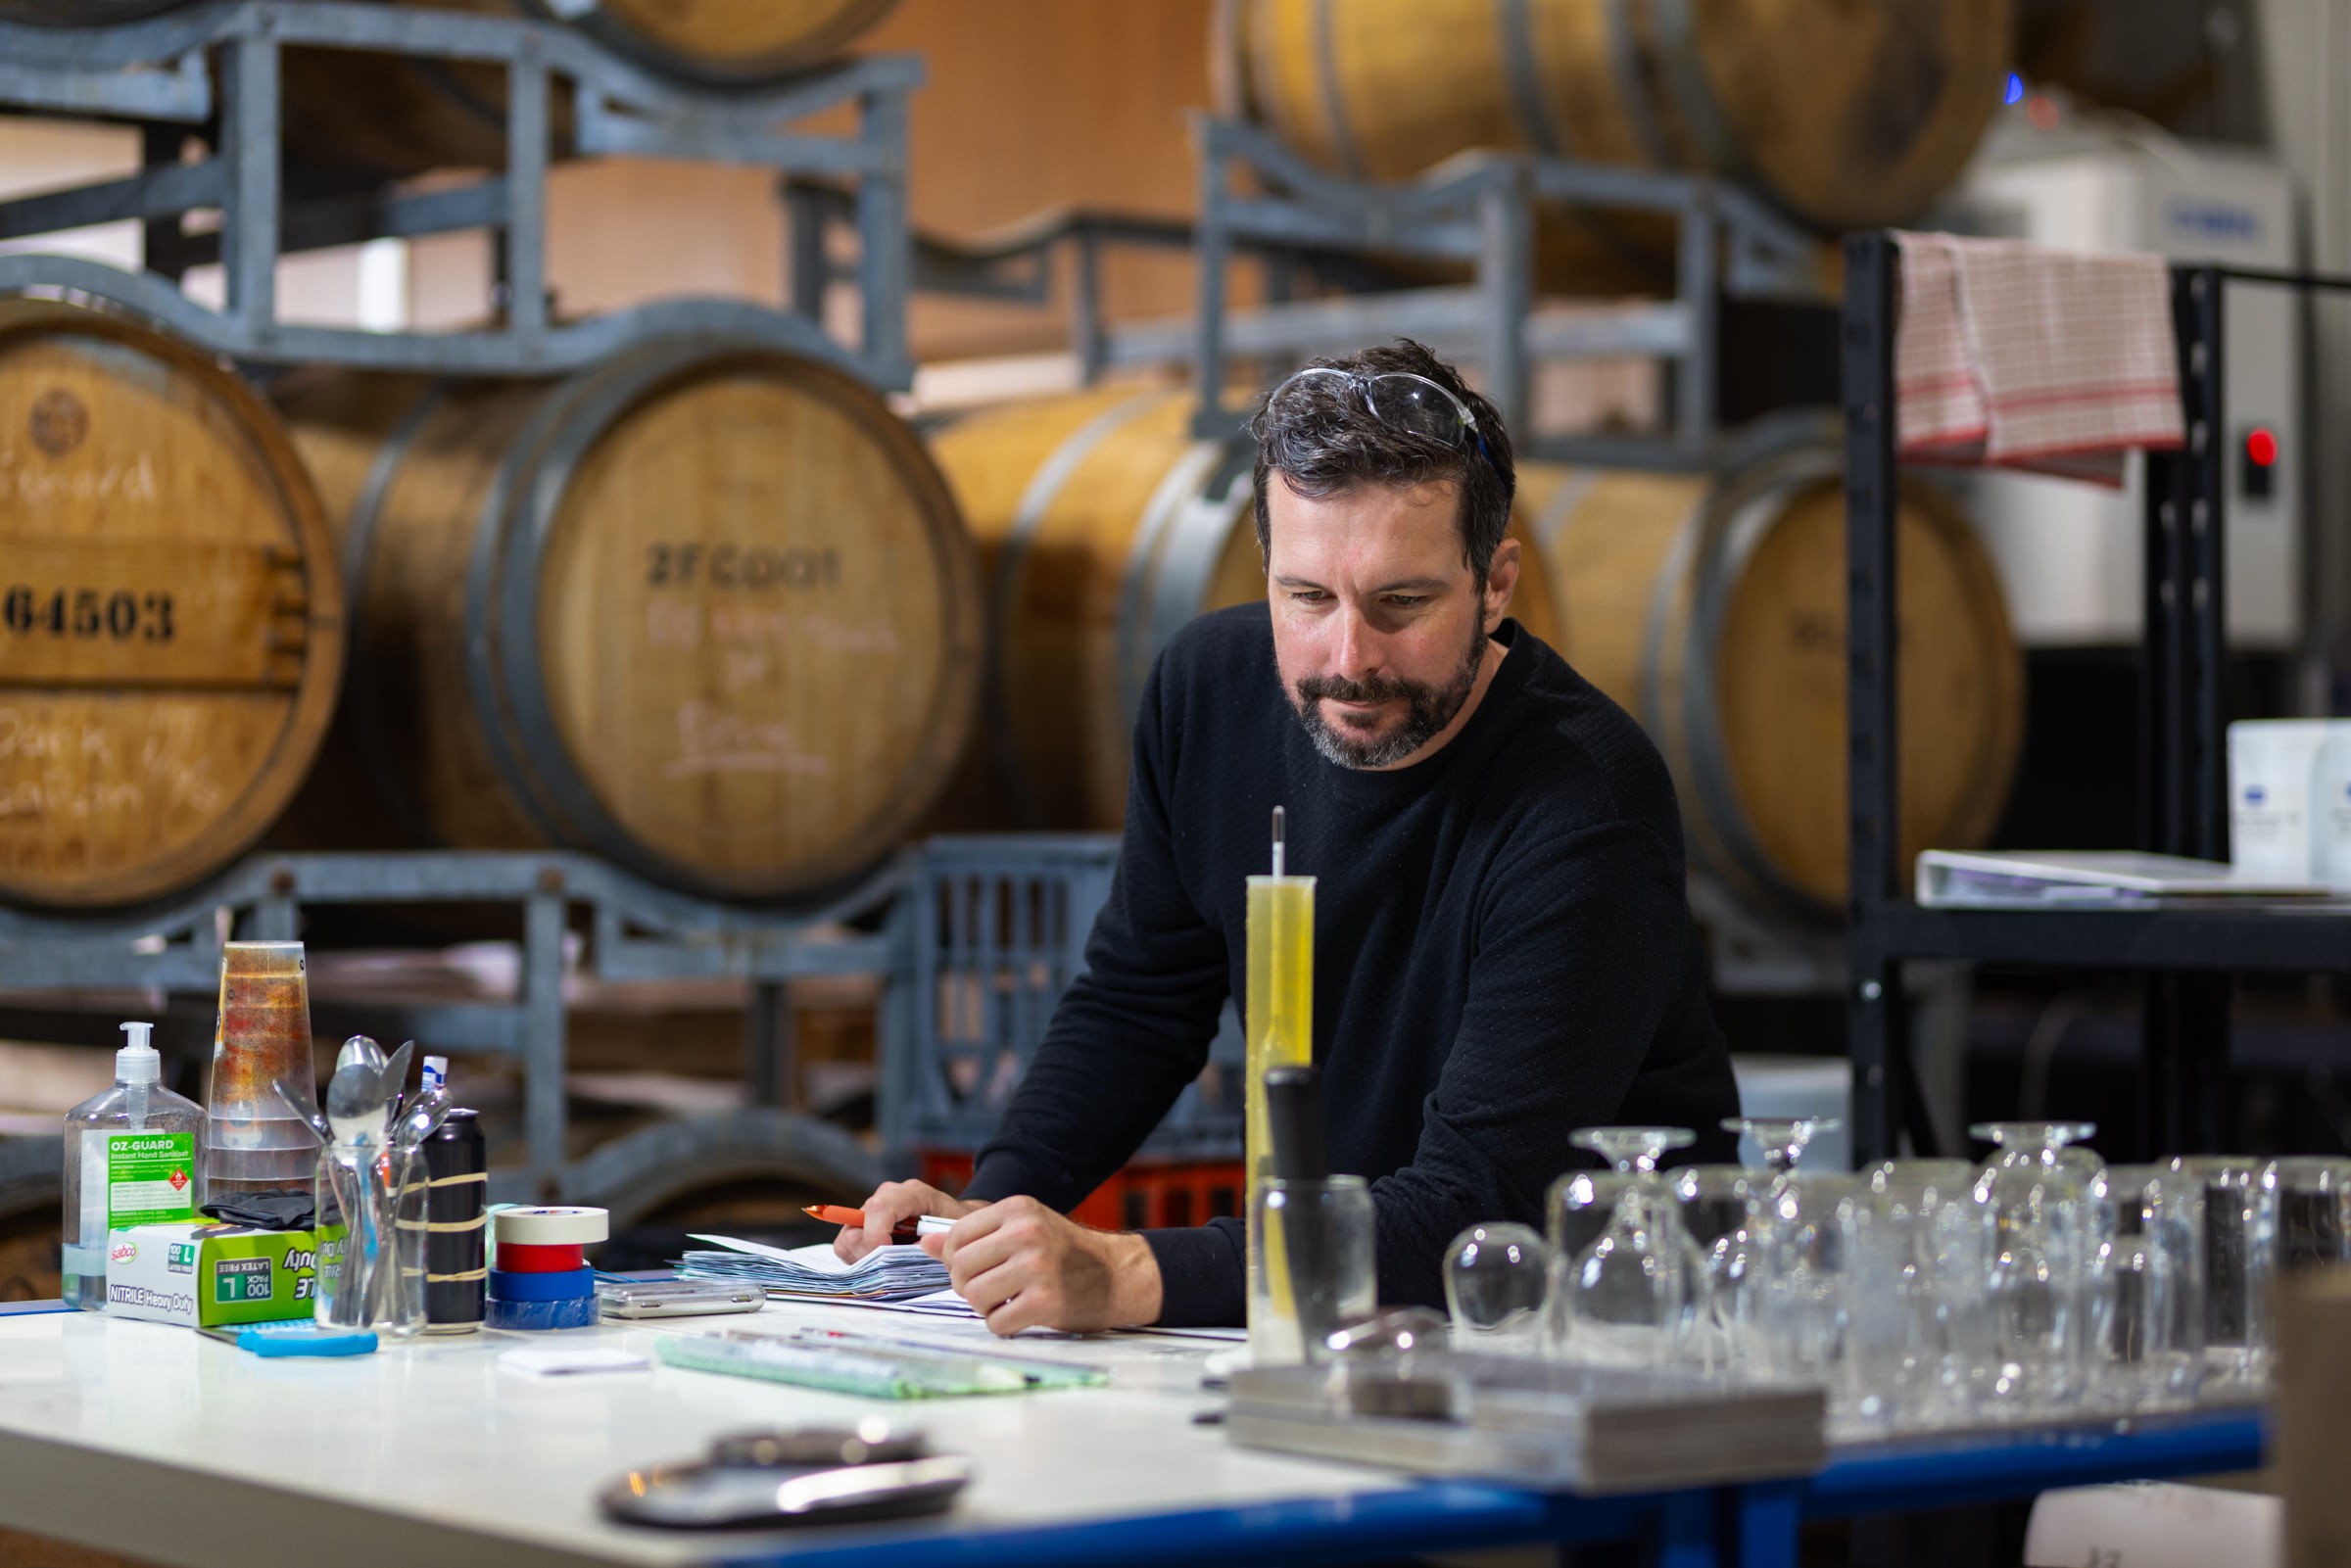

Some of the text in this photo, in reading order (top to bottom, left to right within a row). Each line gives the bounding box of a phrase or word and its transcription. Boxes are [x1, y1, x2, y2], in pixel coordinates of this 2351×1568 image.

[5, 586, 174, 643] 64503
[111, 1140, 173, 1151] OZ-GUARD
[111, 1245, 136, 1260] sabco
[170, 1245, 181, 1255] 100
[184, 1246, 191, 1262] L
[218, 1260, 269, 1272] LATEX FREE
[222, 1277, 235, 1298] L
[247, 1283, 269, 1297] 100
[110, 1284, 193, 1315] NITRILE Heavy Duty
